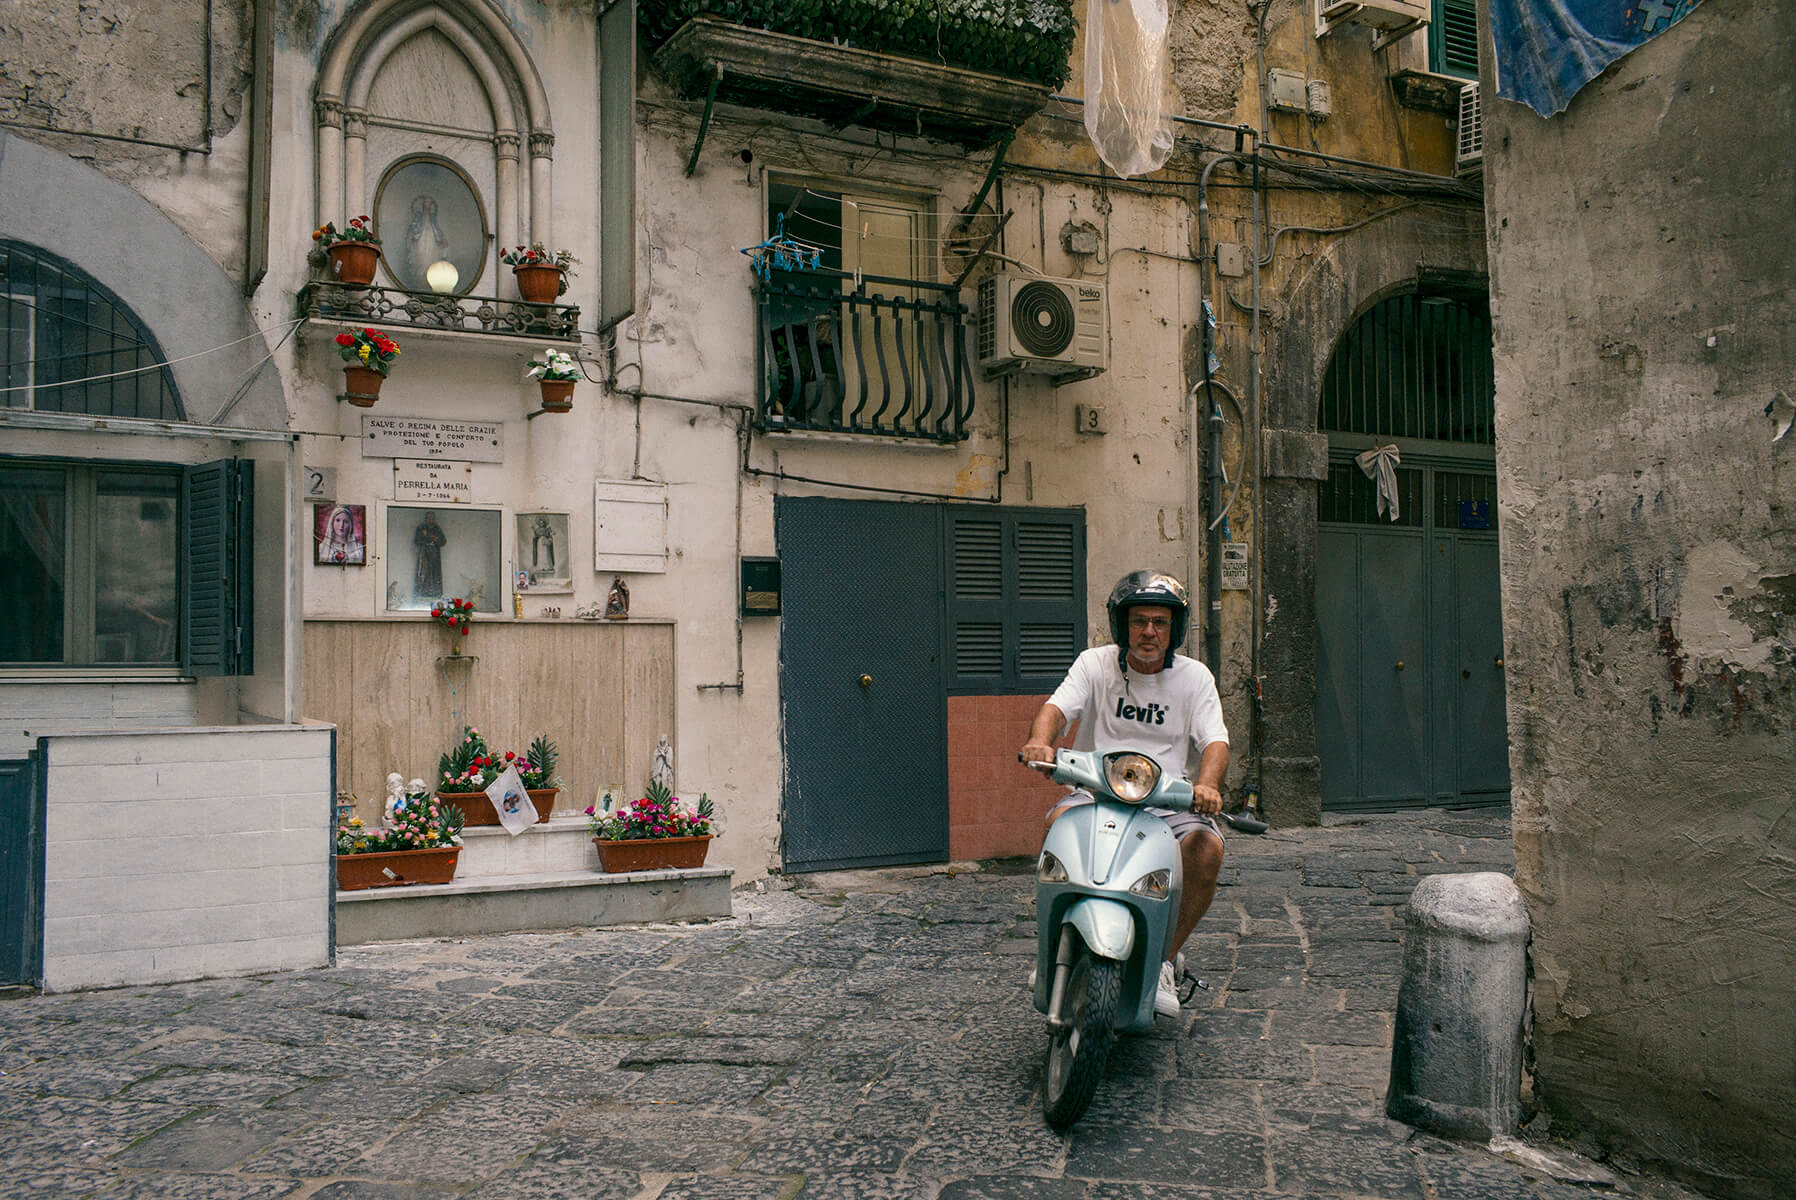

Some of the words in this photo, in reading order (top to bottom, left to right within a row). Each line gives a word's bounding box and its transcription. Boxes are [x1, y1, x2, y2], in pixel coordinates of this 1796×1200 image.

[1079, 287, 1100, 298] beko
[1088, 410, 1097, 428] 3
[370, 420, 395, 428] SALVE
[408, 422, 437, 431] REGINA
[440, 424, 465, 433] DELLE
[469, 426, 497, 434] GRAZIE
[383, 430, 430, 438] PROTEZIONE
[447, 433, 485, 441] CONFORTO
[311, 472, 323, 495] 2
[398, 481, 442, 489] PERRELLA
[443, 483, 469, 491] MARIA
[1115, 697, 1165, 725] levi's
